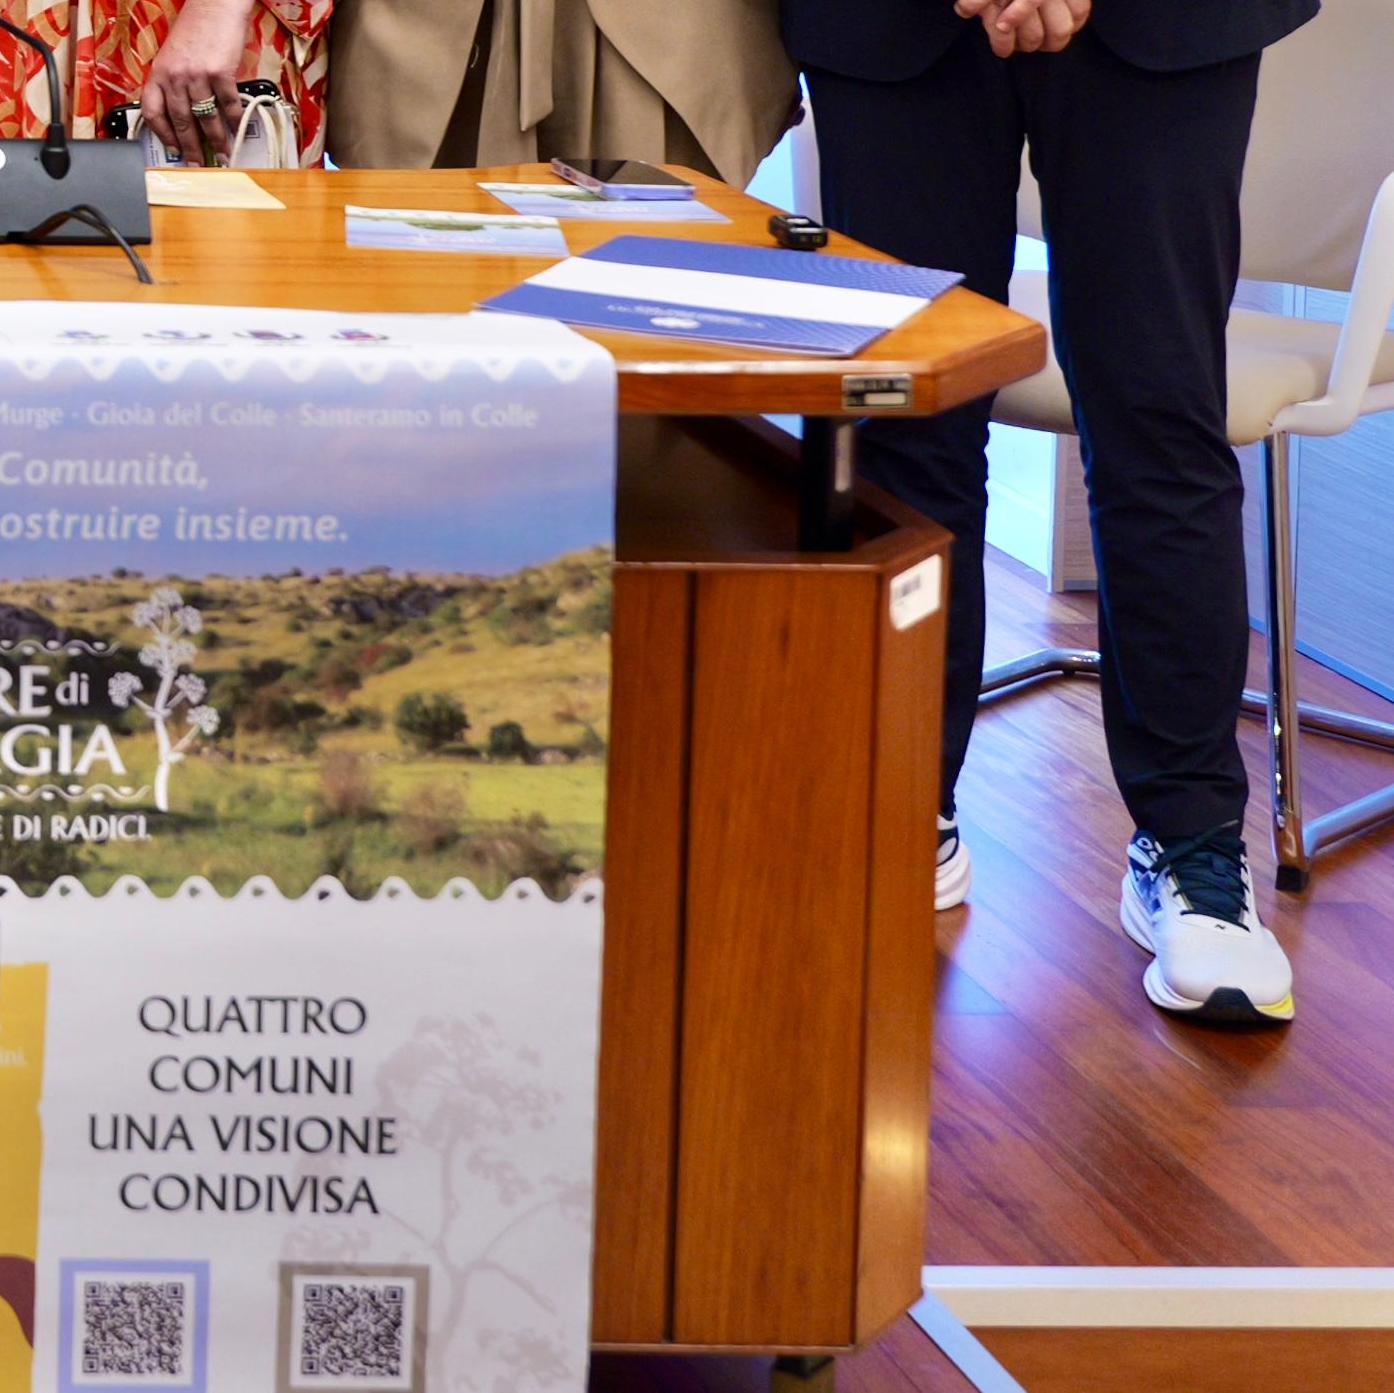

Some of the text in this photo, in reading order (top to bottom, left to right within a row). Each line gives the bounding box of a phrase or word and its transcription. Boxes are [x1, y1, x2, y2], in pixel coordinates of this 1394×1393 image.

[88, 402, 155, 428] Gioia
[164, 402, 201, 427] del
[210, 403, 277, 427] Colle
[299, 403, 430, 428] Santeramo
[439, 404, 463, 428] in
[471, 404, 538, 428] Colle
[175, 507, 349, 542] insieme.
[55, 673, 90, 706] di
[13, 814, 42, 840] DI
[138, 997, 368, 1036] QUATTRO
[149, 1055, 354, 1095] COMUNI
[88, 1113, 397, 1155] UNA VISIONE
[119, 1173, 380, 1215] CONDIVISA
